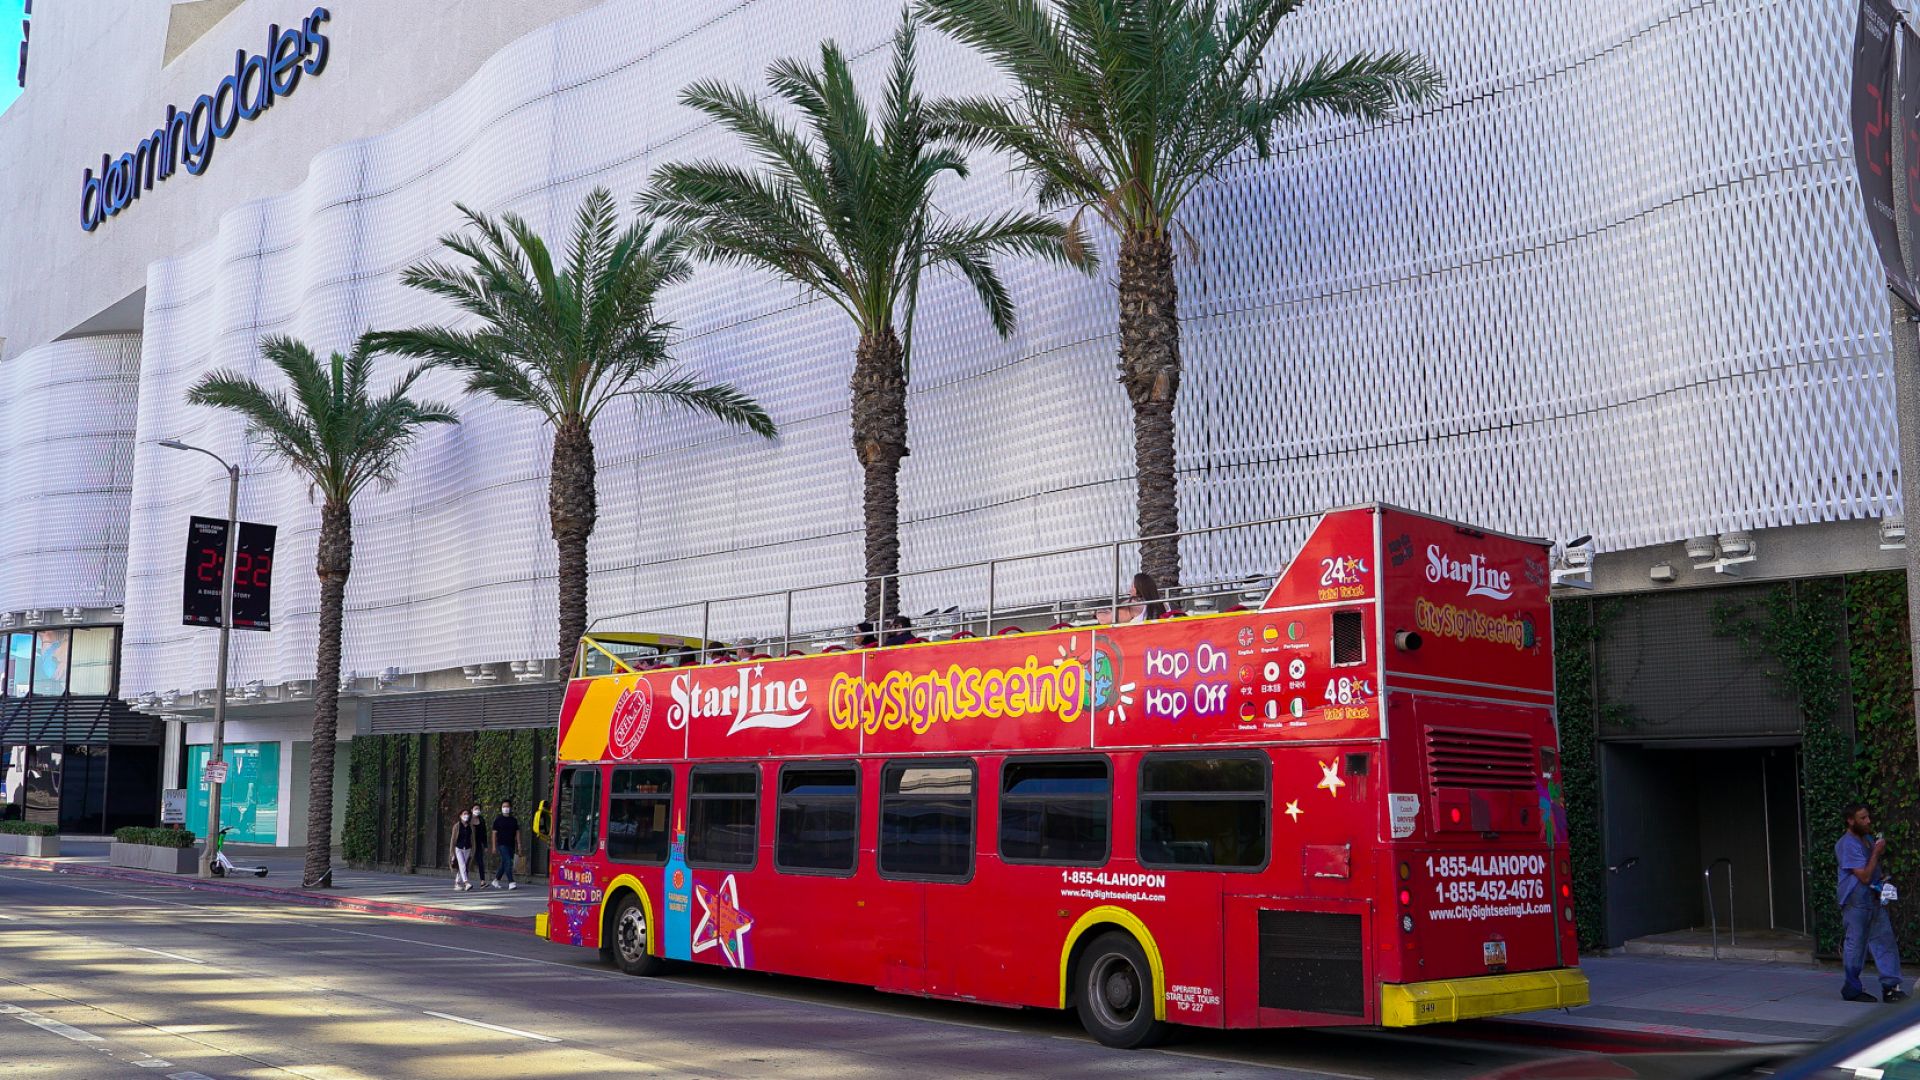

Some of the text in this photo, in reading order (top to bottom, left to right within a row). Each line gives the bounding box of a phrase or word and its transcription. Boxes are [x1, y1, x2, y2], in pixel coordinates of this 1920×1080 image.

[1321, 557, 1345, 586] 24
[1146, 643, 1227, 679] Hop On
[1146, 683, 1229, 719] Hop Off
[1324, 676, 1352, 705] 48
[1061, 870, 1165, 888] 1-855-4LAHOPON
[1436, 879, 1544, 903] 1-855-452-4676
[1061, 889, 1166, 902] www.CitySightseeingLA.com
[1429, 902, 1552, 921] www.CitySightseeingLA.com
[1198, 995, 1220, 1005] TOURS
